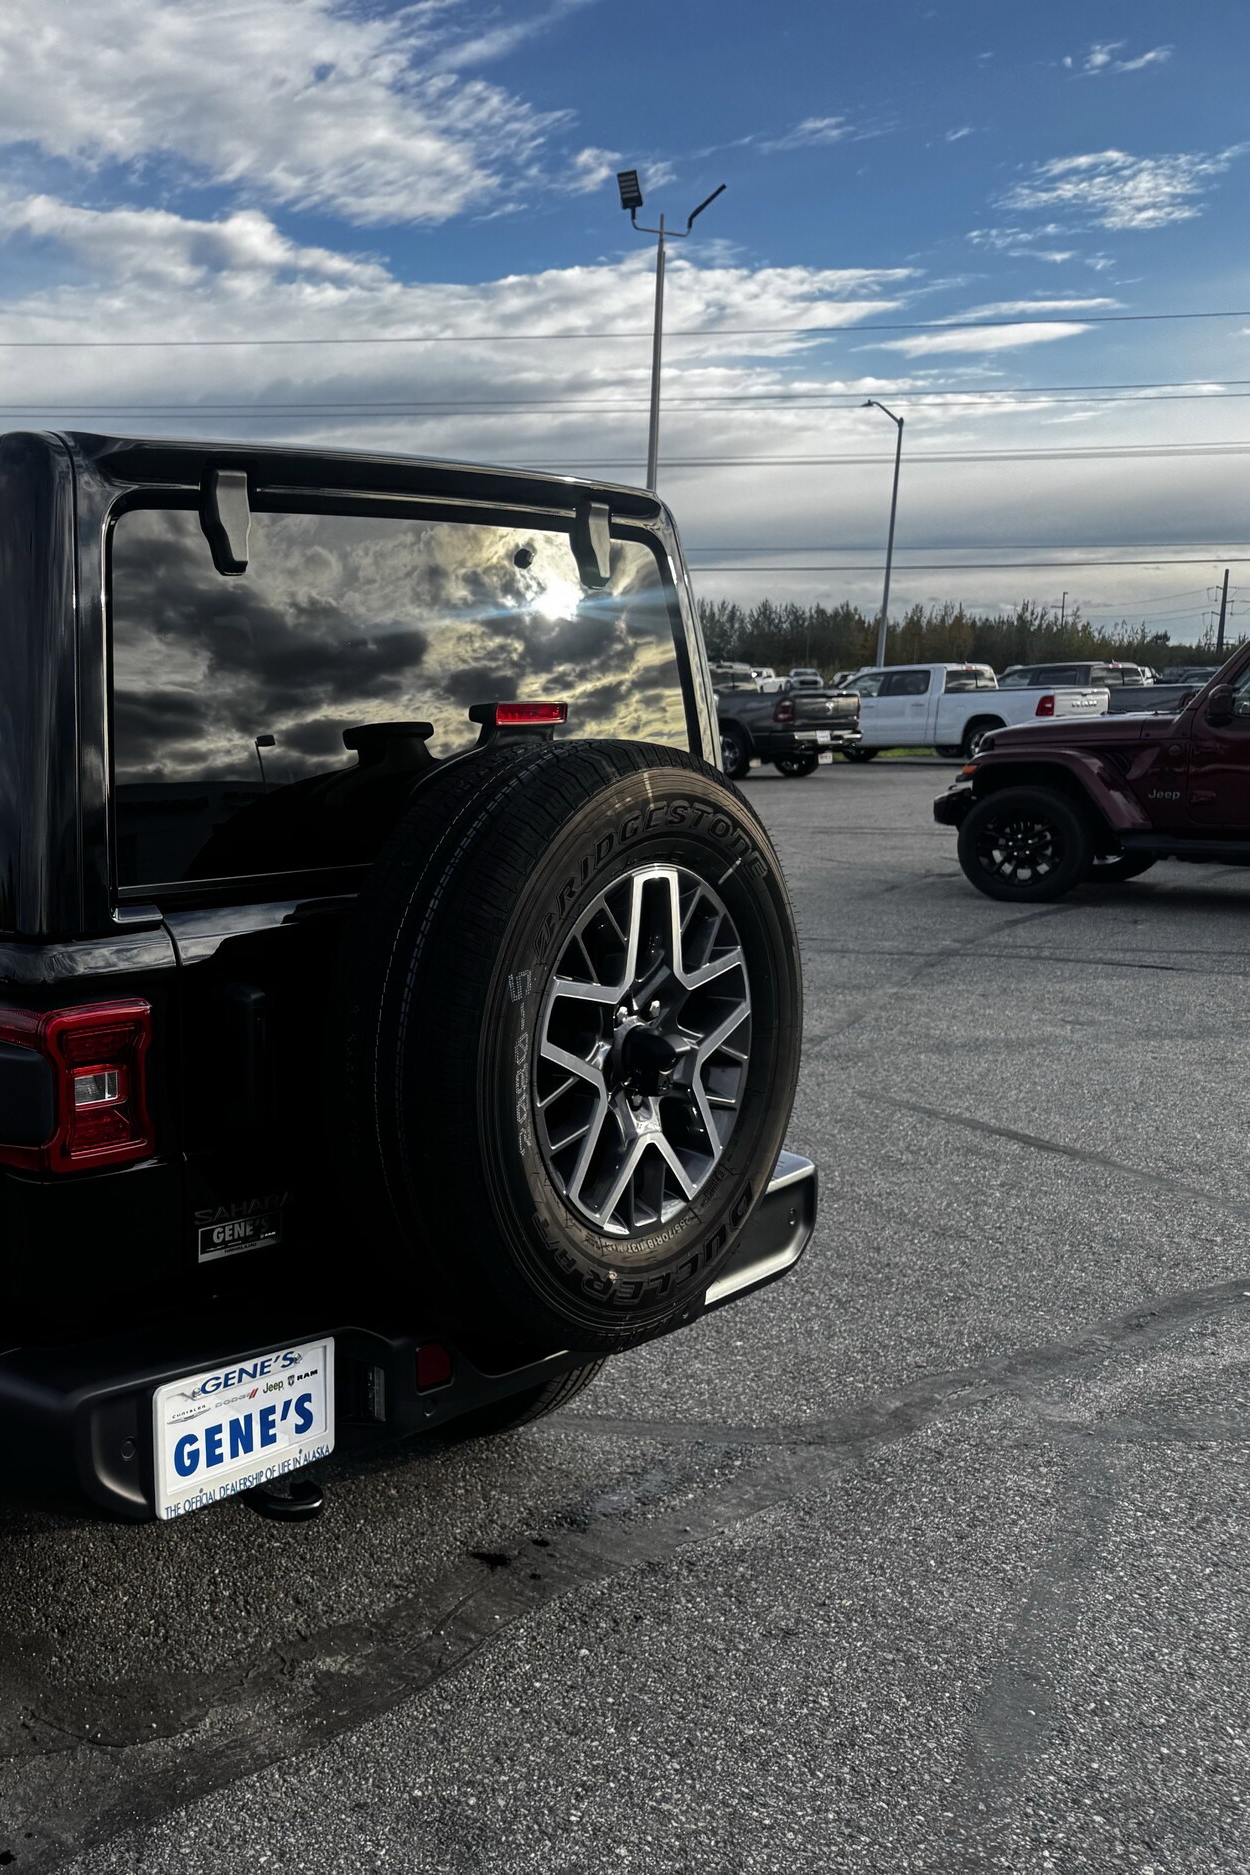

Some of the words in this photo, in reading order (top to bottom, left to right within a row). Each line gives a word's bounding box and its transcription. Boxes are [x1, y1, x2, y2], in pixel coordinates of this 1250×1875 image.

[1148, 788, 1181, 801] Jeep
[534, 799, 768, 960] BRIDGESTONE
[580, 1179, 754, 1306] DUELER
[200, 1350, 296, 1396] GENE'S
[262, 1380, 284, 1394] Jeep
[296, 1368, 319, 1381] RAM
[173, 1392, 315, 1478] GENE'S
[164, 1502, 181, 1519] THE
[183, 1489, 217, 1513] OFFICIAL
[219, 1470, 264, 1499] DEALERSHIP
[264, 1464, 276, 1480] OF
[278, 1458, 291, 1475] LIFE
[292, 1455, 301, 1469] IN
[303, 1443, 330, 1465] ALASKA
